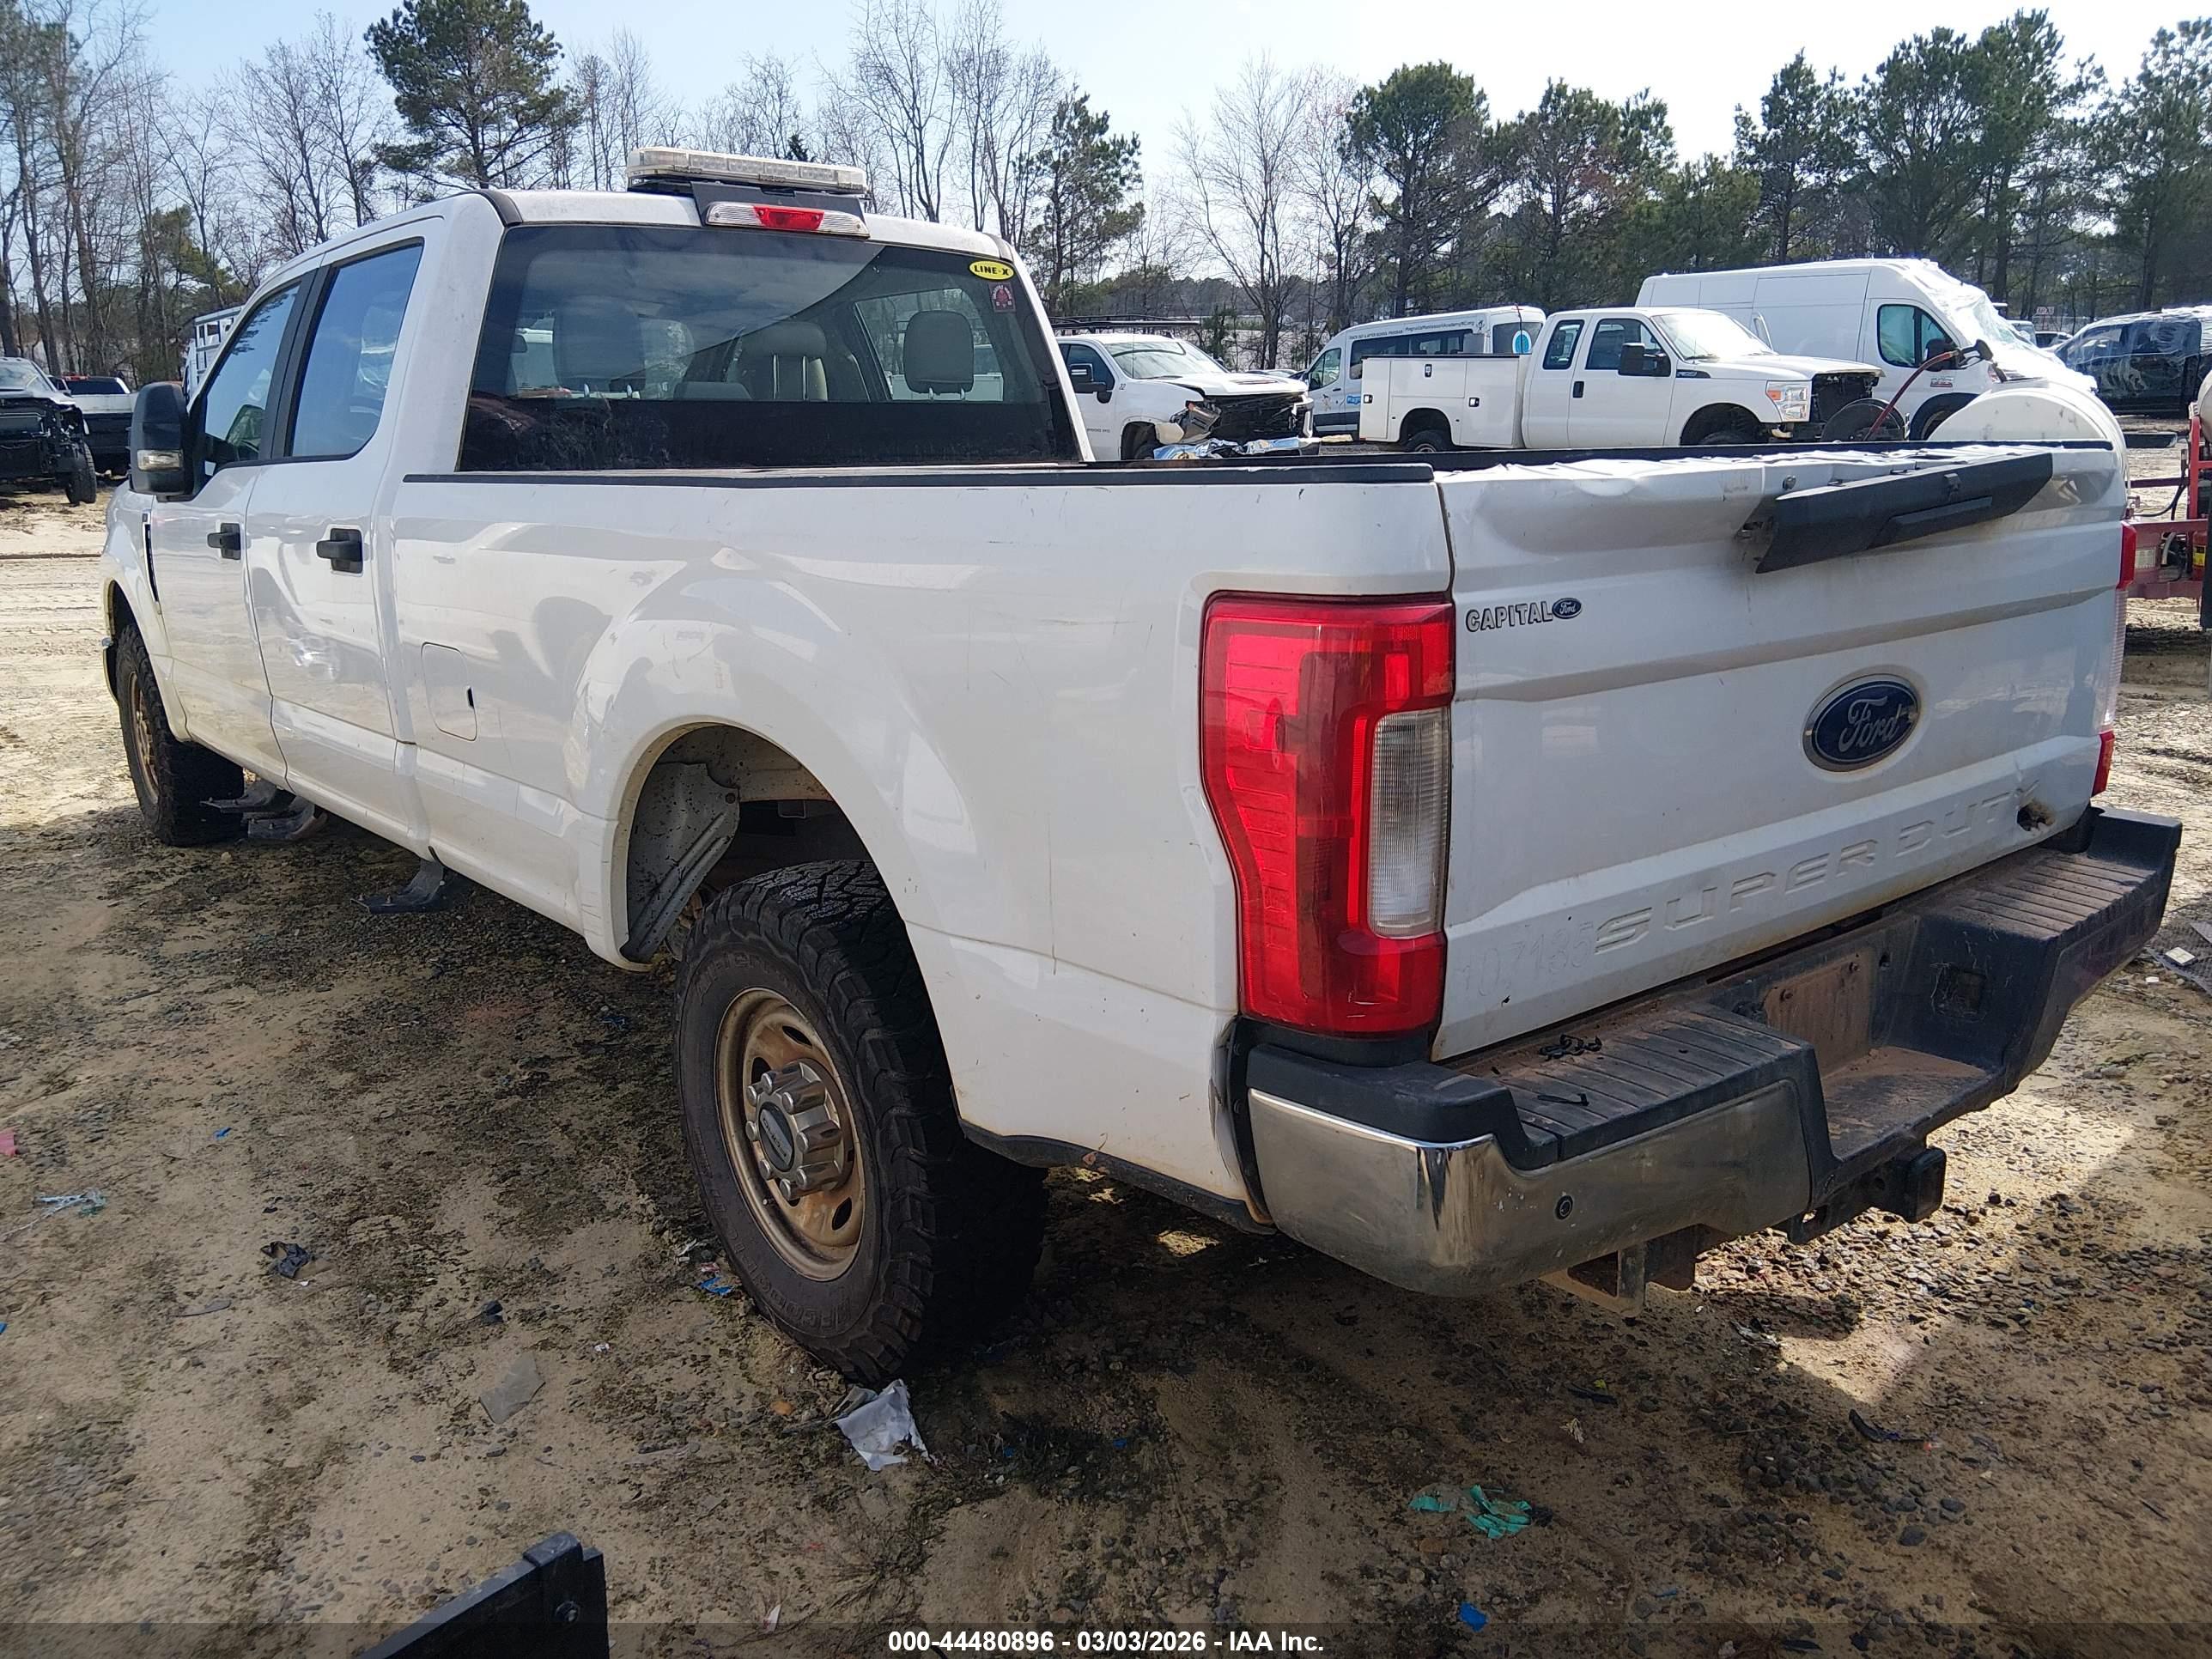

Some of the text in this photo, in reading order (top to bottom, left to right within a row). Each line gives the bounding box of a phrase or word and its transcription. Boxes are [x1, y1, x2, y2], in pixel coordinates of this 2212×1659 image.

[1466, 601, 1553, 632] CAPITAL
[1838, 695, 1903, 752] Ford
[1595, 838, 1879, 955] SUPER
